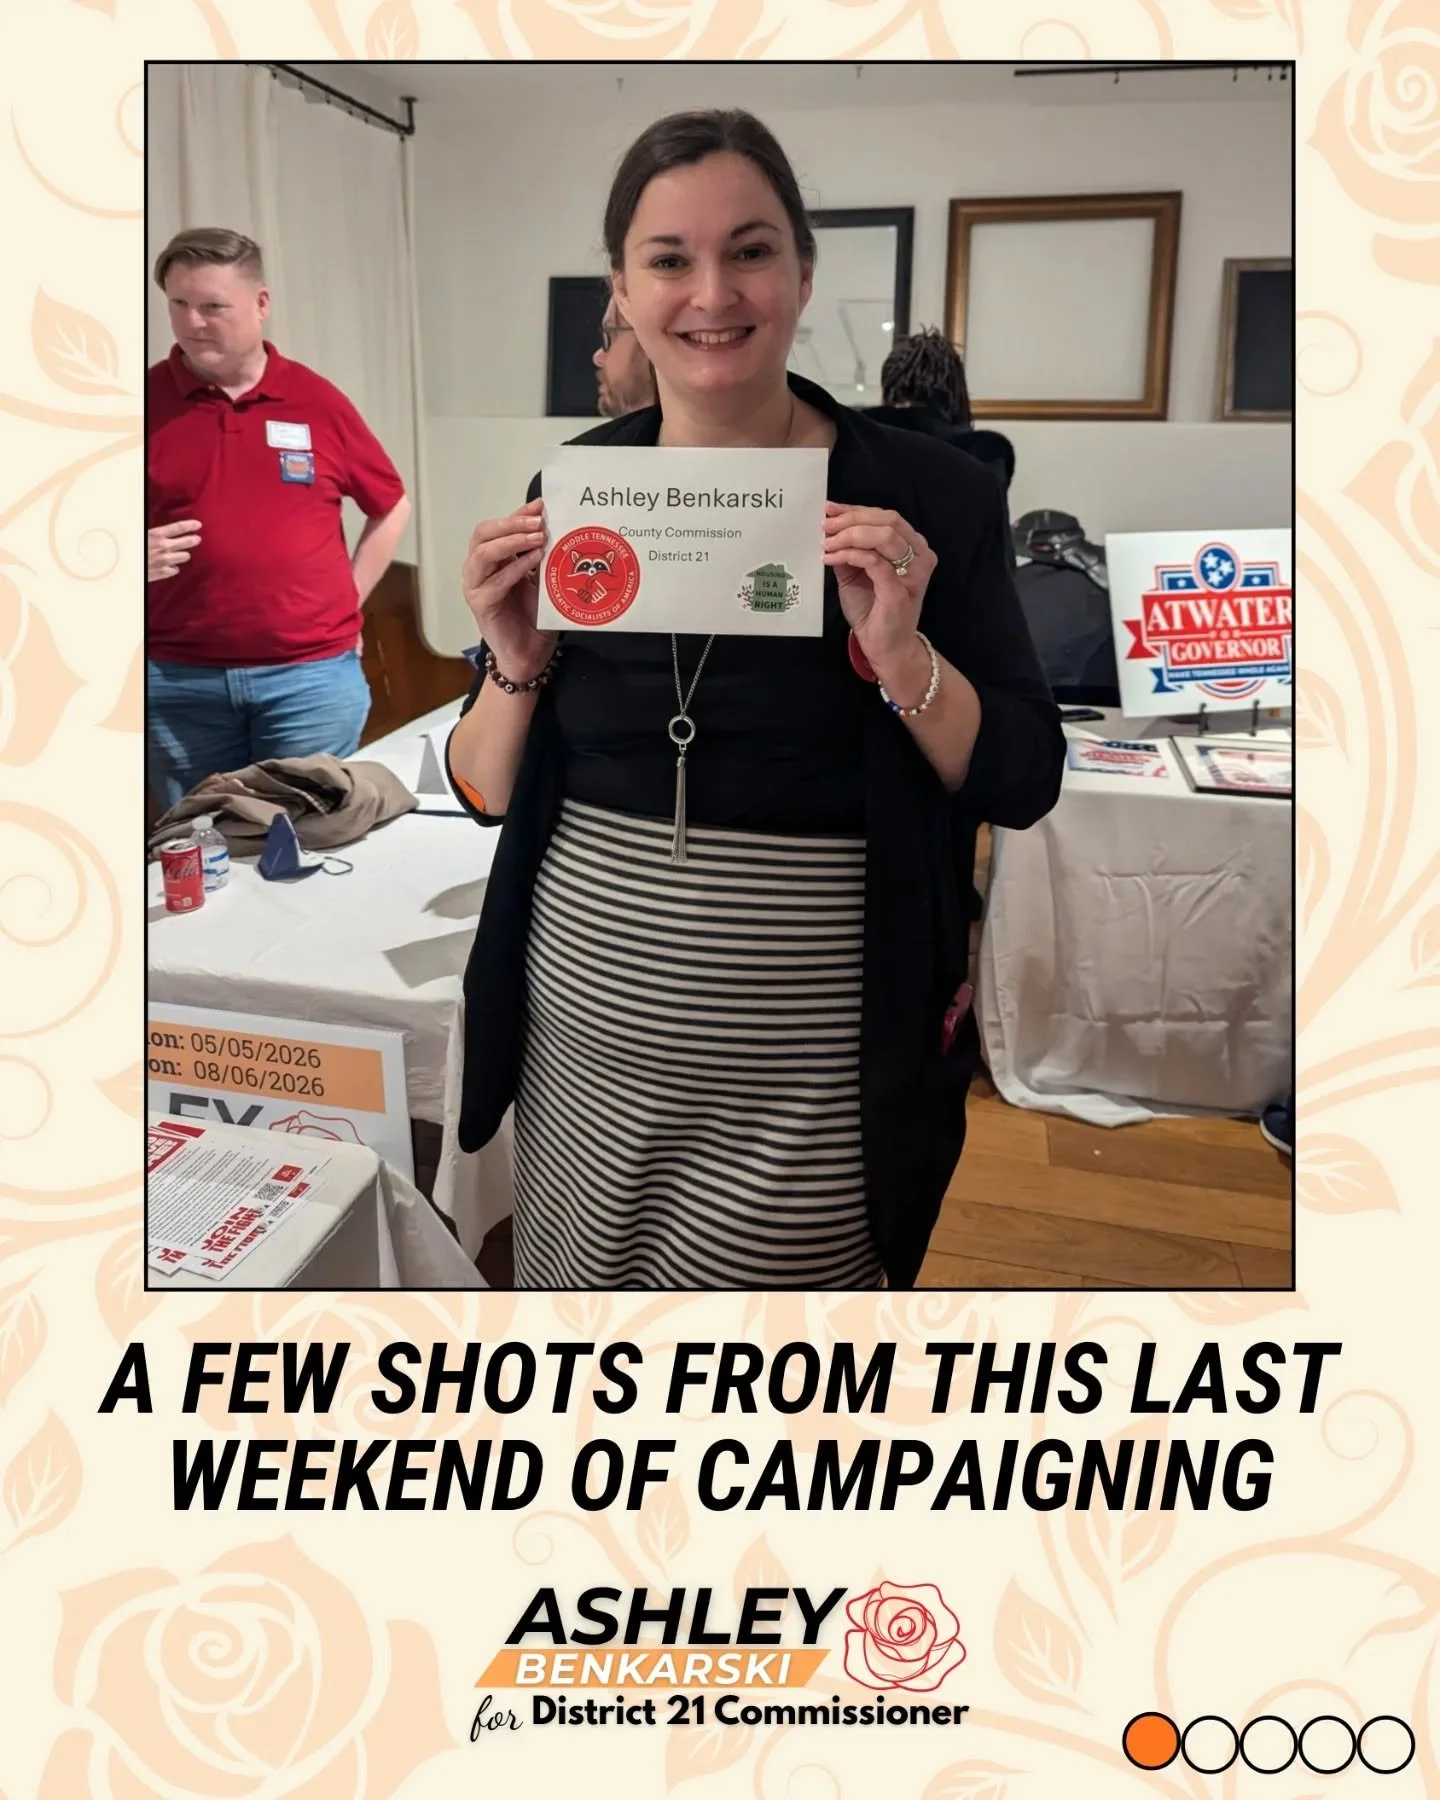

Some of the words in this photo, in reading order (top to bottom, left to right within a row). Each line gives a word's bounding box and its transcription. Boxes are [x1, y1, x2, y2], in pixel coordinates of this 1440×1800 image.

[579, 486, 660, 511] Ashley
[666, 487, 783, 508] Benkarski
[618, 526, 661, 539] County
[664, 526, 742, 539] Commission
[561, 532, 589, 552] MIDDLE
[591, 532, 630, 559] TENNESSEE
[648, 549, 693, 562] District
[695, 551, 709, 562] 21
[551, 566, 572, 612] DEMOCRATIC
[571, 608, 611, 620] SOCIALISTS
[612, 602, 621, 612] OF
[620, 571, 635, 604] AMERICA
[754, 600, 785, 609] RIGHT
[755, 590, 784, 599] HUMAN
[1147, 597, 1291, 631] ATWATER
[1171, 638, 1281, 661] GOVERNOR
[148, 1031, 185, 1050] on:
[190, 1032, 322, 1069] 05/05/2026
[193, 1060, 326, 1097] 08/06/2026
[201, 1206, 249, 1250] JOIN
[207, 1235, 237, 1253] THE
